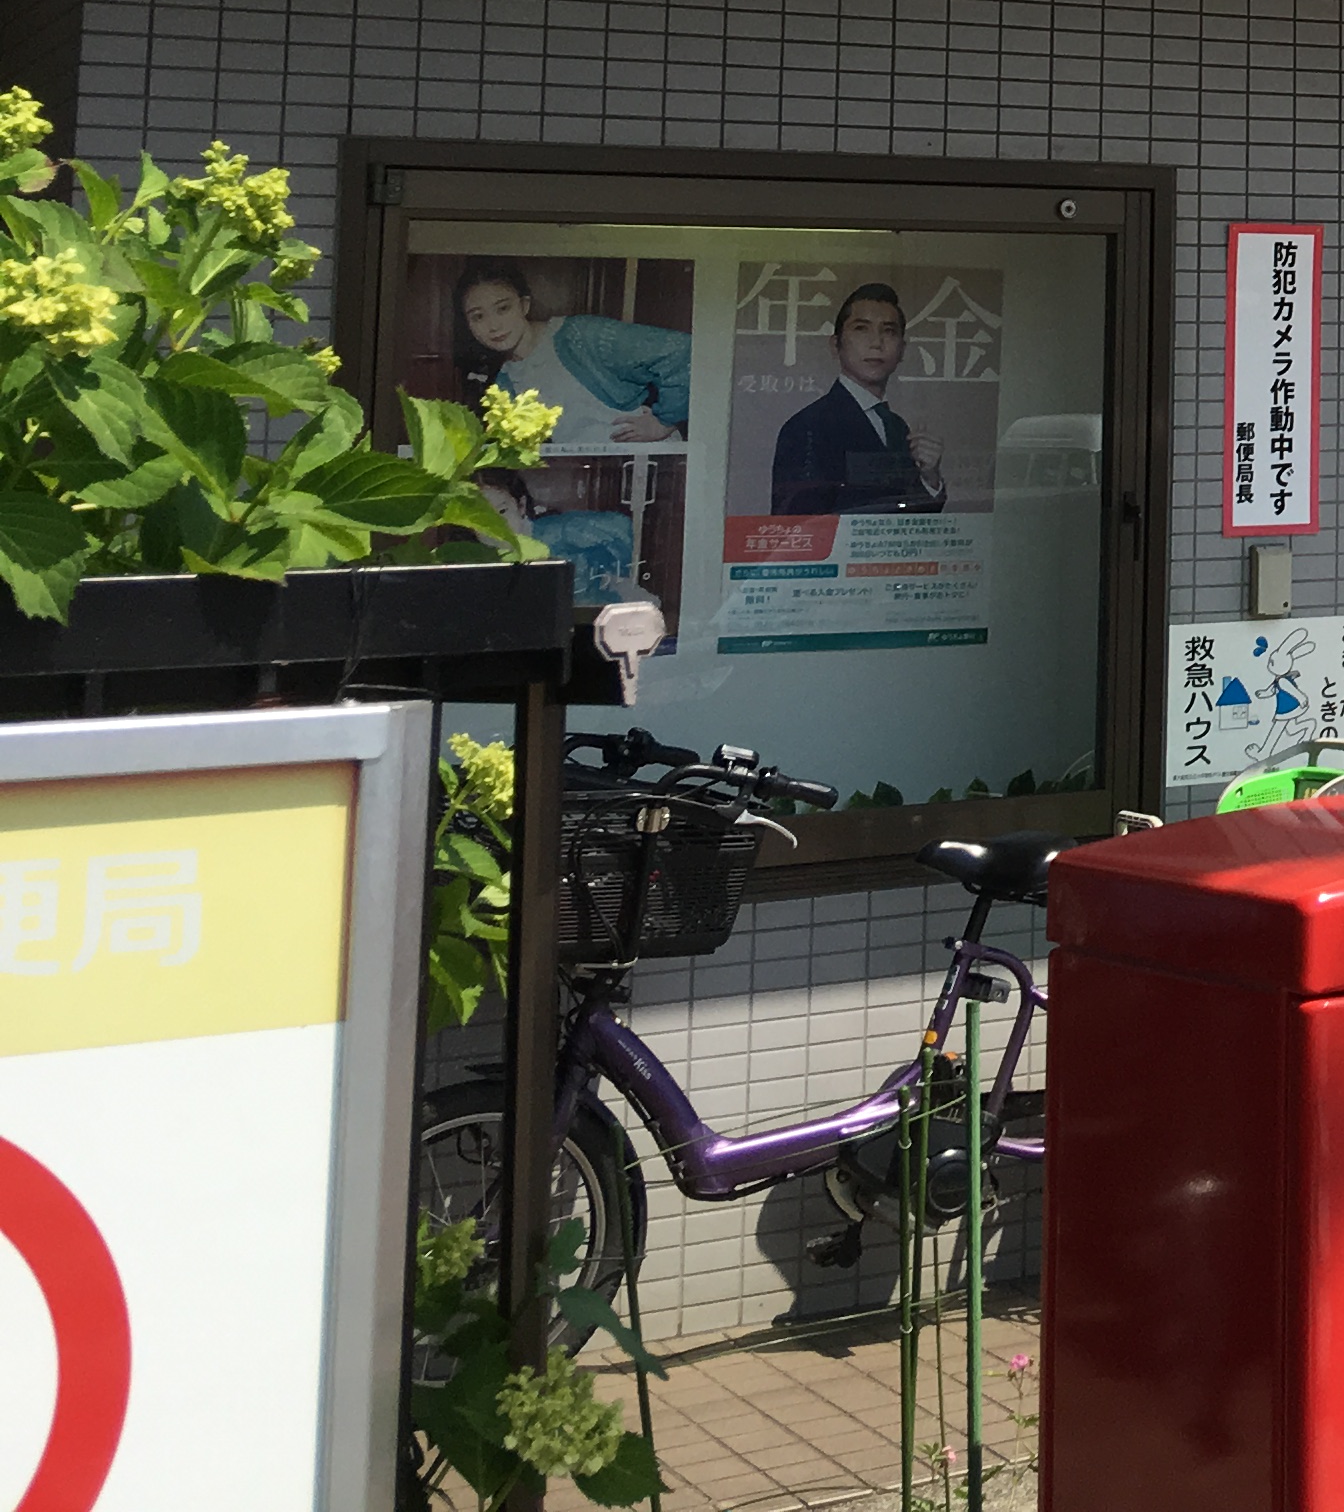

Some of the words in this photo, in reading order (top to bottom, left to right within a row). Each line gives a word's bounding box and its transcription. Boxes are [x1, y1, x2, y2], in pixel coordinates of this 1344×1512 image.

[1269, 241, 1298, 516] 防犯カメラ作動中です
[1235, 422, 1256, 504] 郵便局長
[745, 537, 813, 550] 年金サービス
[1184, 635, 1216, 767] 救急ハウス
[1319, 676, 1339, 739] ときの
